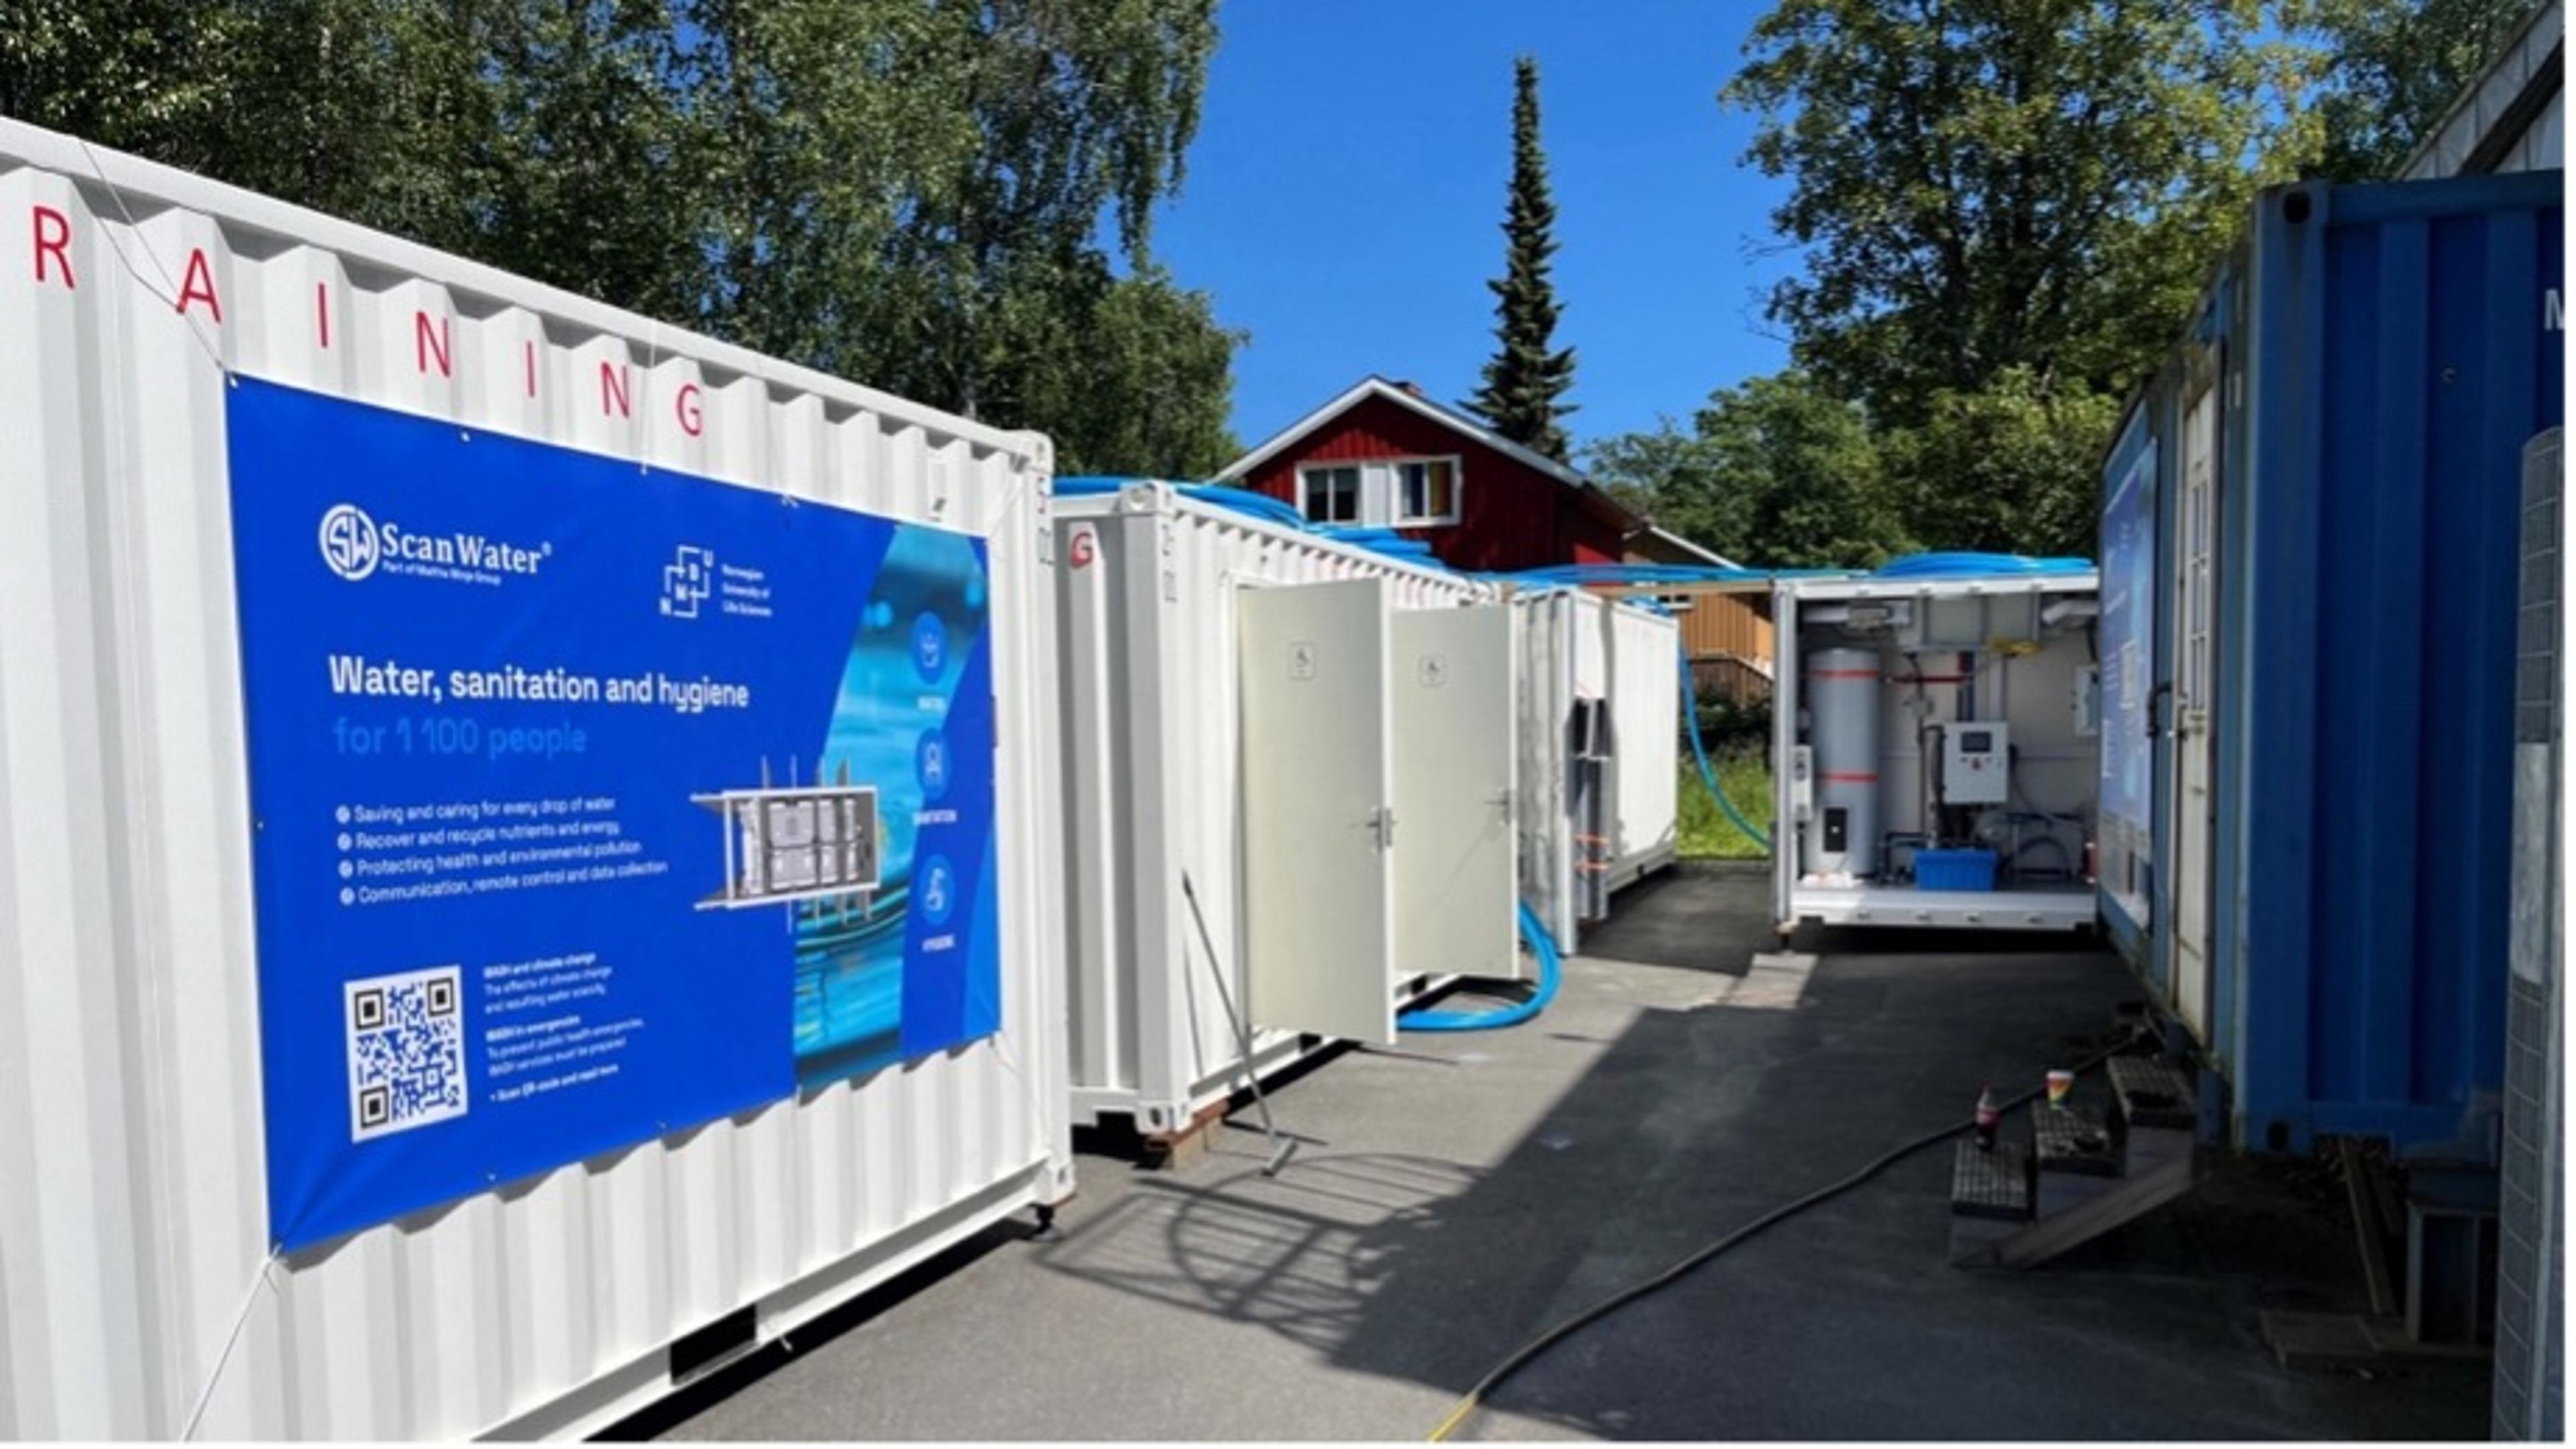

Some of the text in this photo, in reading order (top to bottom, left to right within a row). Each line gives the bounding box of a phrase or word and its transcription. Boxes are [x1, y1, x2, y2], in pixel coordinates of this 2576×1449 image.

[1069, 531, 1093, 569] G
[329, 654, 749, 713] Water, sanitation and hygiene
[333, 716, 386, 754] for
[488, 720, 586, 759] people
[354, 796, 615, 825] Saving and caring for every drop of water
[356, 820, 620, 849] Recover and recycle nutrients and energy
[357, 858, 434, 875] Protecting
[436, 853, 479, 869] health
[483, 850, 506, 866] and
[594, 840, 641, 859] pollution
[472, 873, 518, 892] remote
[522, 868, 566, 886] control
[567, 867, 588, 883] and
[589, 865, 616, 879] data
[617, 861, 668, 877] collection
